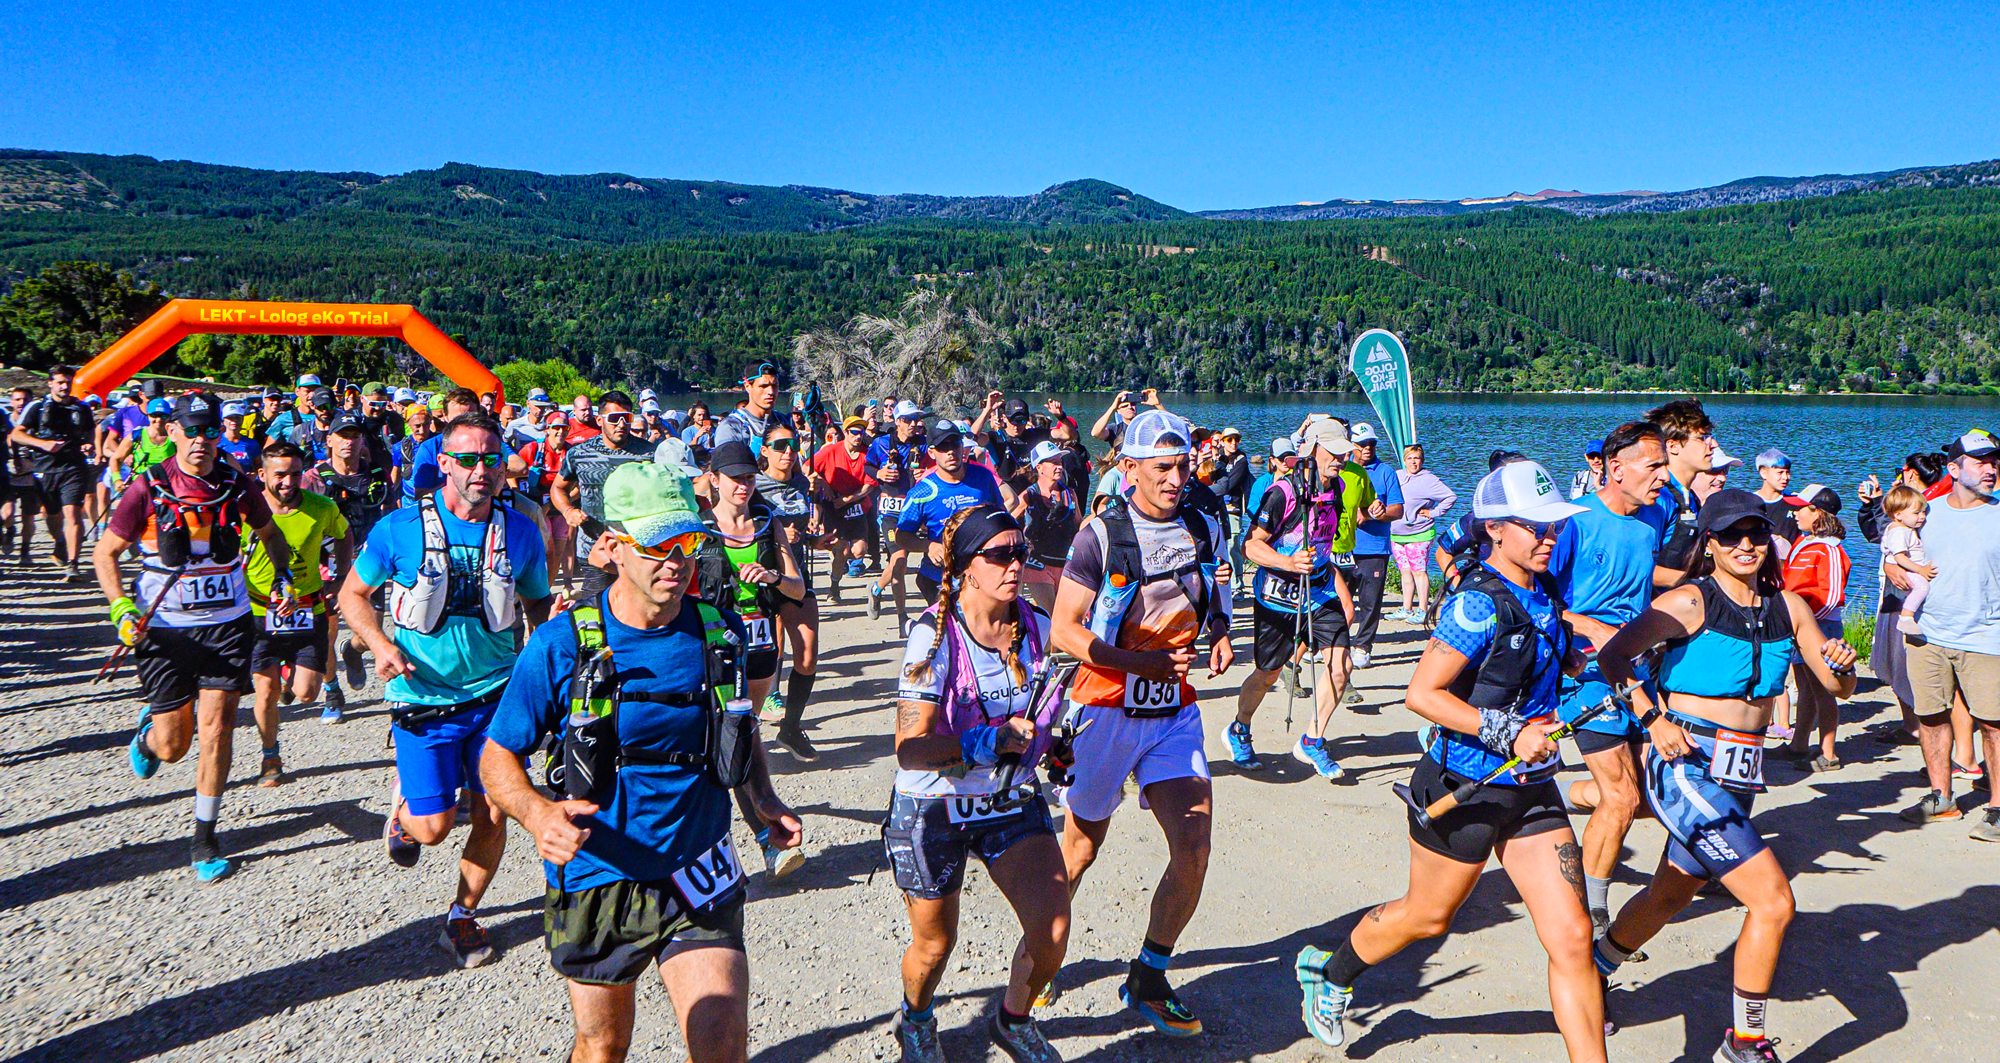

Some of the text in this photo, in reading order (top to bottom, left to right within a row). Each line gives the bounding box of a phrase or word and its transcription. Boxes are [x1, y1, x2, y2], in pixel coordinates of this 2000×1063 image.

[200, 308, 246, 322] LEKT
[259, 309, 308, 326] Lolog
[311, 310, 345, 325] eKo
[348, 311, 389, 325] Trial
[1536, 482, 1555, 496] LEKT
[882, 498, 902, 510] 031
[189, 575, 230, 600] 164
[272, 608, 309, 629] 042
[745, 619, 767, 644] 14
[980, 680, 1036, 702] saucon
[1724, 745, 1760, 780] 158
[1745, 1001, 1764, 1029] NONO
